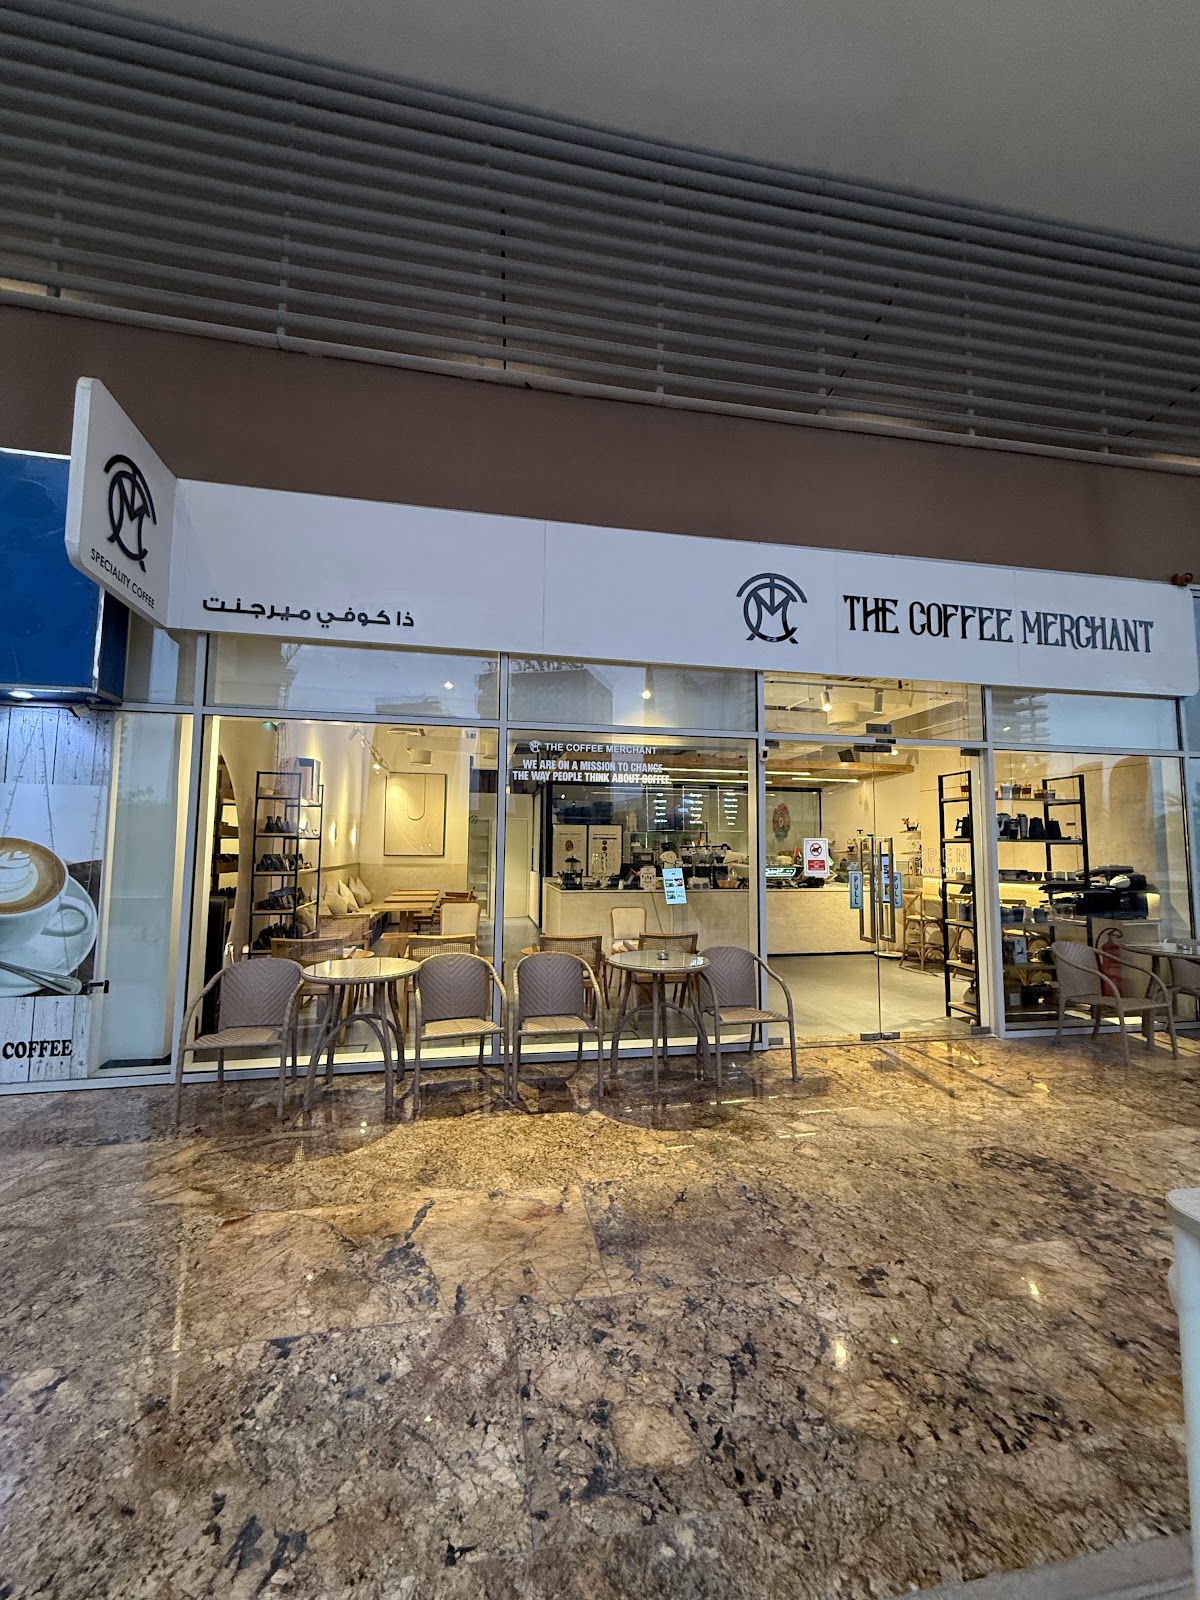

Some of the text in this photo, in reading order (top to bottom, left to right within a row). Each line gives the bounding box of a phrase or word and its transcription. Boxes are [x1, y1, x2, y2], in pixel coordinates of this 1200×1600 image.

[90, 547, 155, 609] SPECIALITY COFFEE
[202, 597, 415, 629] ذا كوفي ميرجنت
[843, 594, 1154, 653] THE COFFEE MERCHANT
[544, 742, 658, 755] THE COFFEE MERCHANT
[522, 759, 663, 773] WE ARE ON A MISSION TO CHANGE
[512, 771, 529, 781] THE
[531, 771, 551, 781] WAY
[552, 772, 583, 782] PEOPLE
[584, 772, 610, 783] THINK
[611, 773, 640, 784] ABOUT
[924, 867, 935, 875] AM
[2, 1039, 73, 1060] COFFEE
